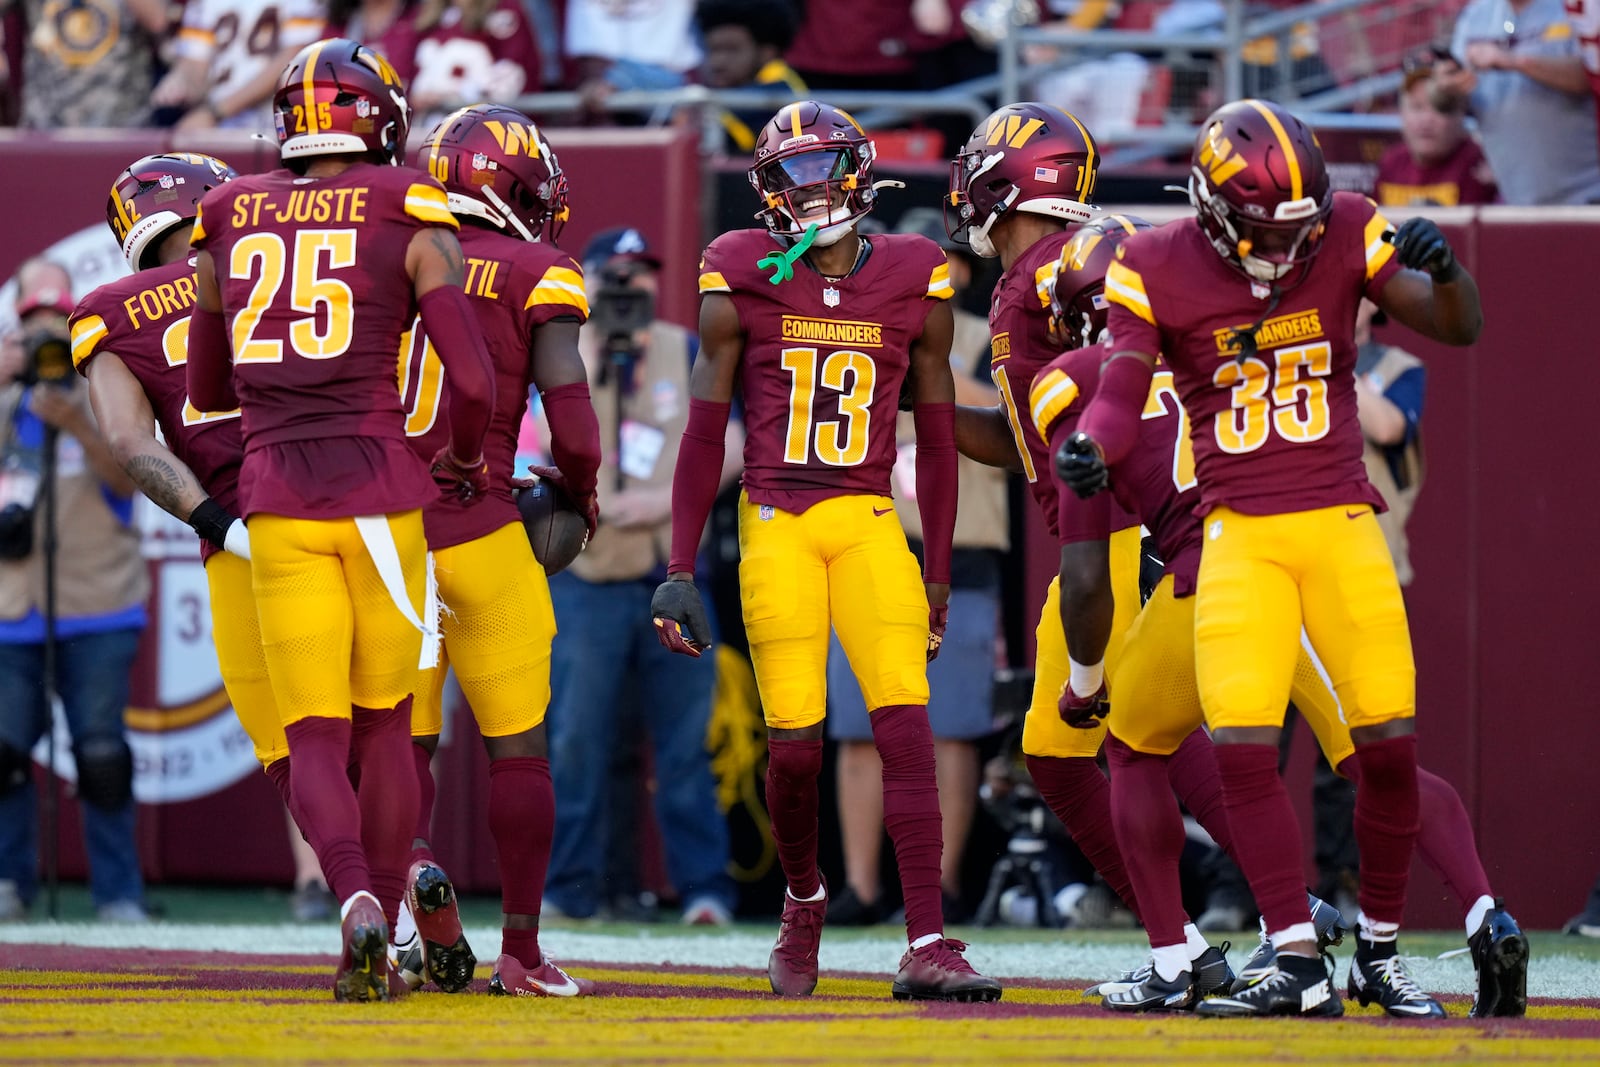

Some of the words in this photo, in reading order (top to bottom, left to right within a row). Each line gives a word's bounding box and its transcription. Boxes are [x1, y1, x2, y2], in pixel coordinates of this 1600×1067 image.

[293, 102, 333, 133] 25
[231, 187, 369, 229] ST-JUSTE
[229, 228, 357, 365] 25
[781, 319, 882, 344] COMMANDERS
[781, 347, 877, 466] 13
[1213, 341, 1333, 454] 35
